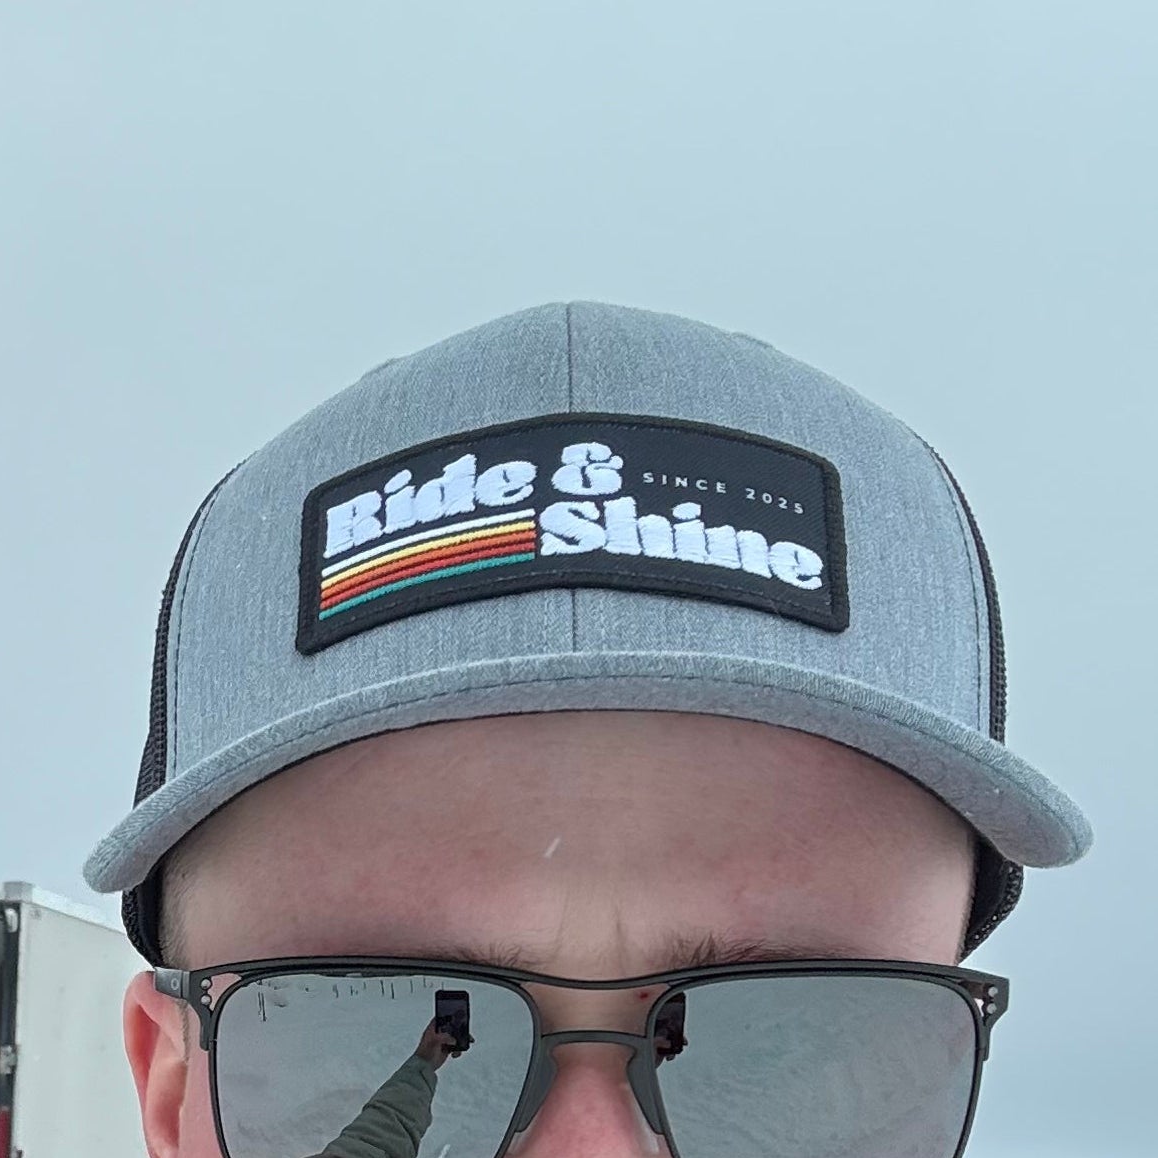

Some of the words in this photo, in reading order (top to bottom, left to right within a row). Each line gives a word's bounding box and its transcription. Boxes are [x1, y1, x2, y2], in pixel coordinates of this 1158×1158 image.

[324, 453, 537, 558] Ride
[551, 441, 624, 496] &
[642, 471, 727, 494] SINCE
[745, 487, 805, 515] 2025
[539, 496, 824, 590] Shine
